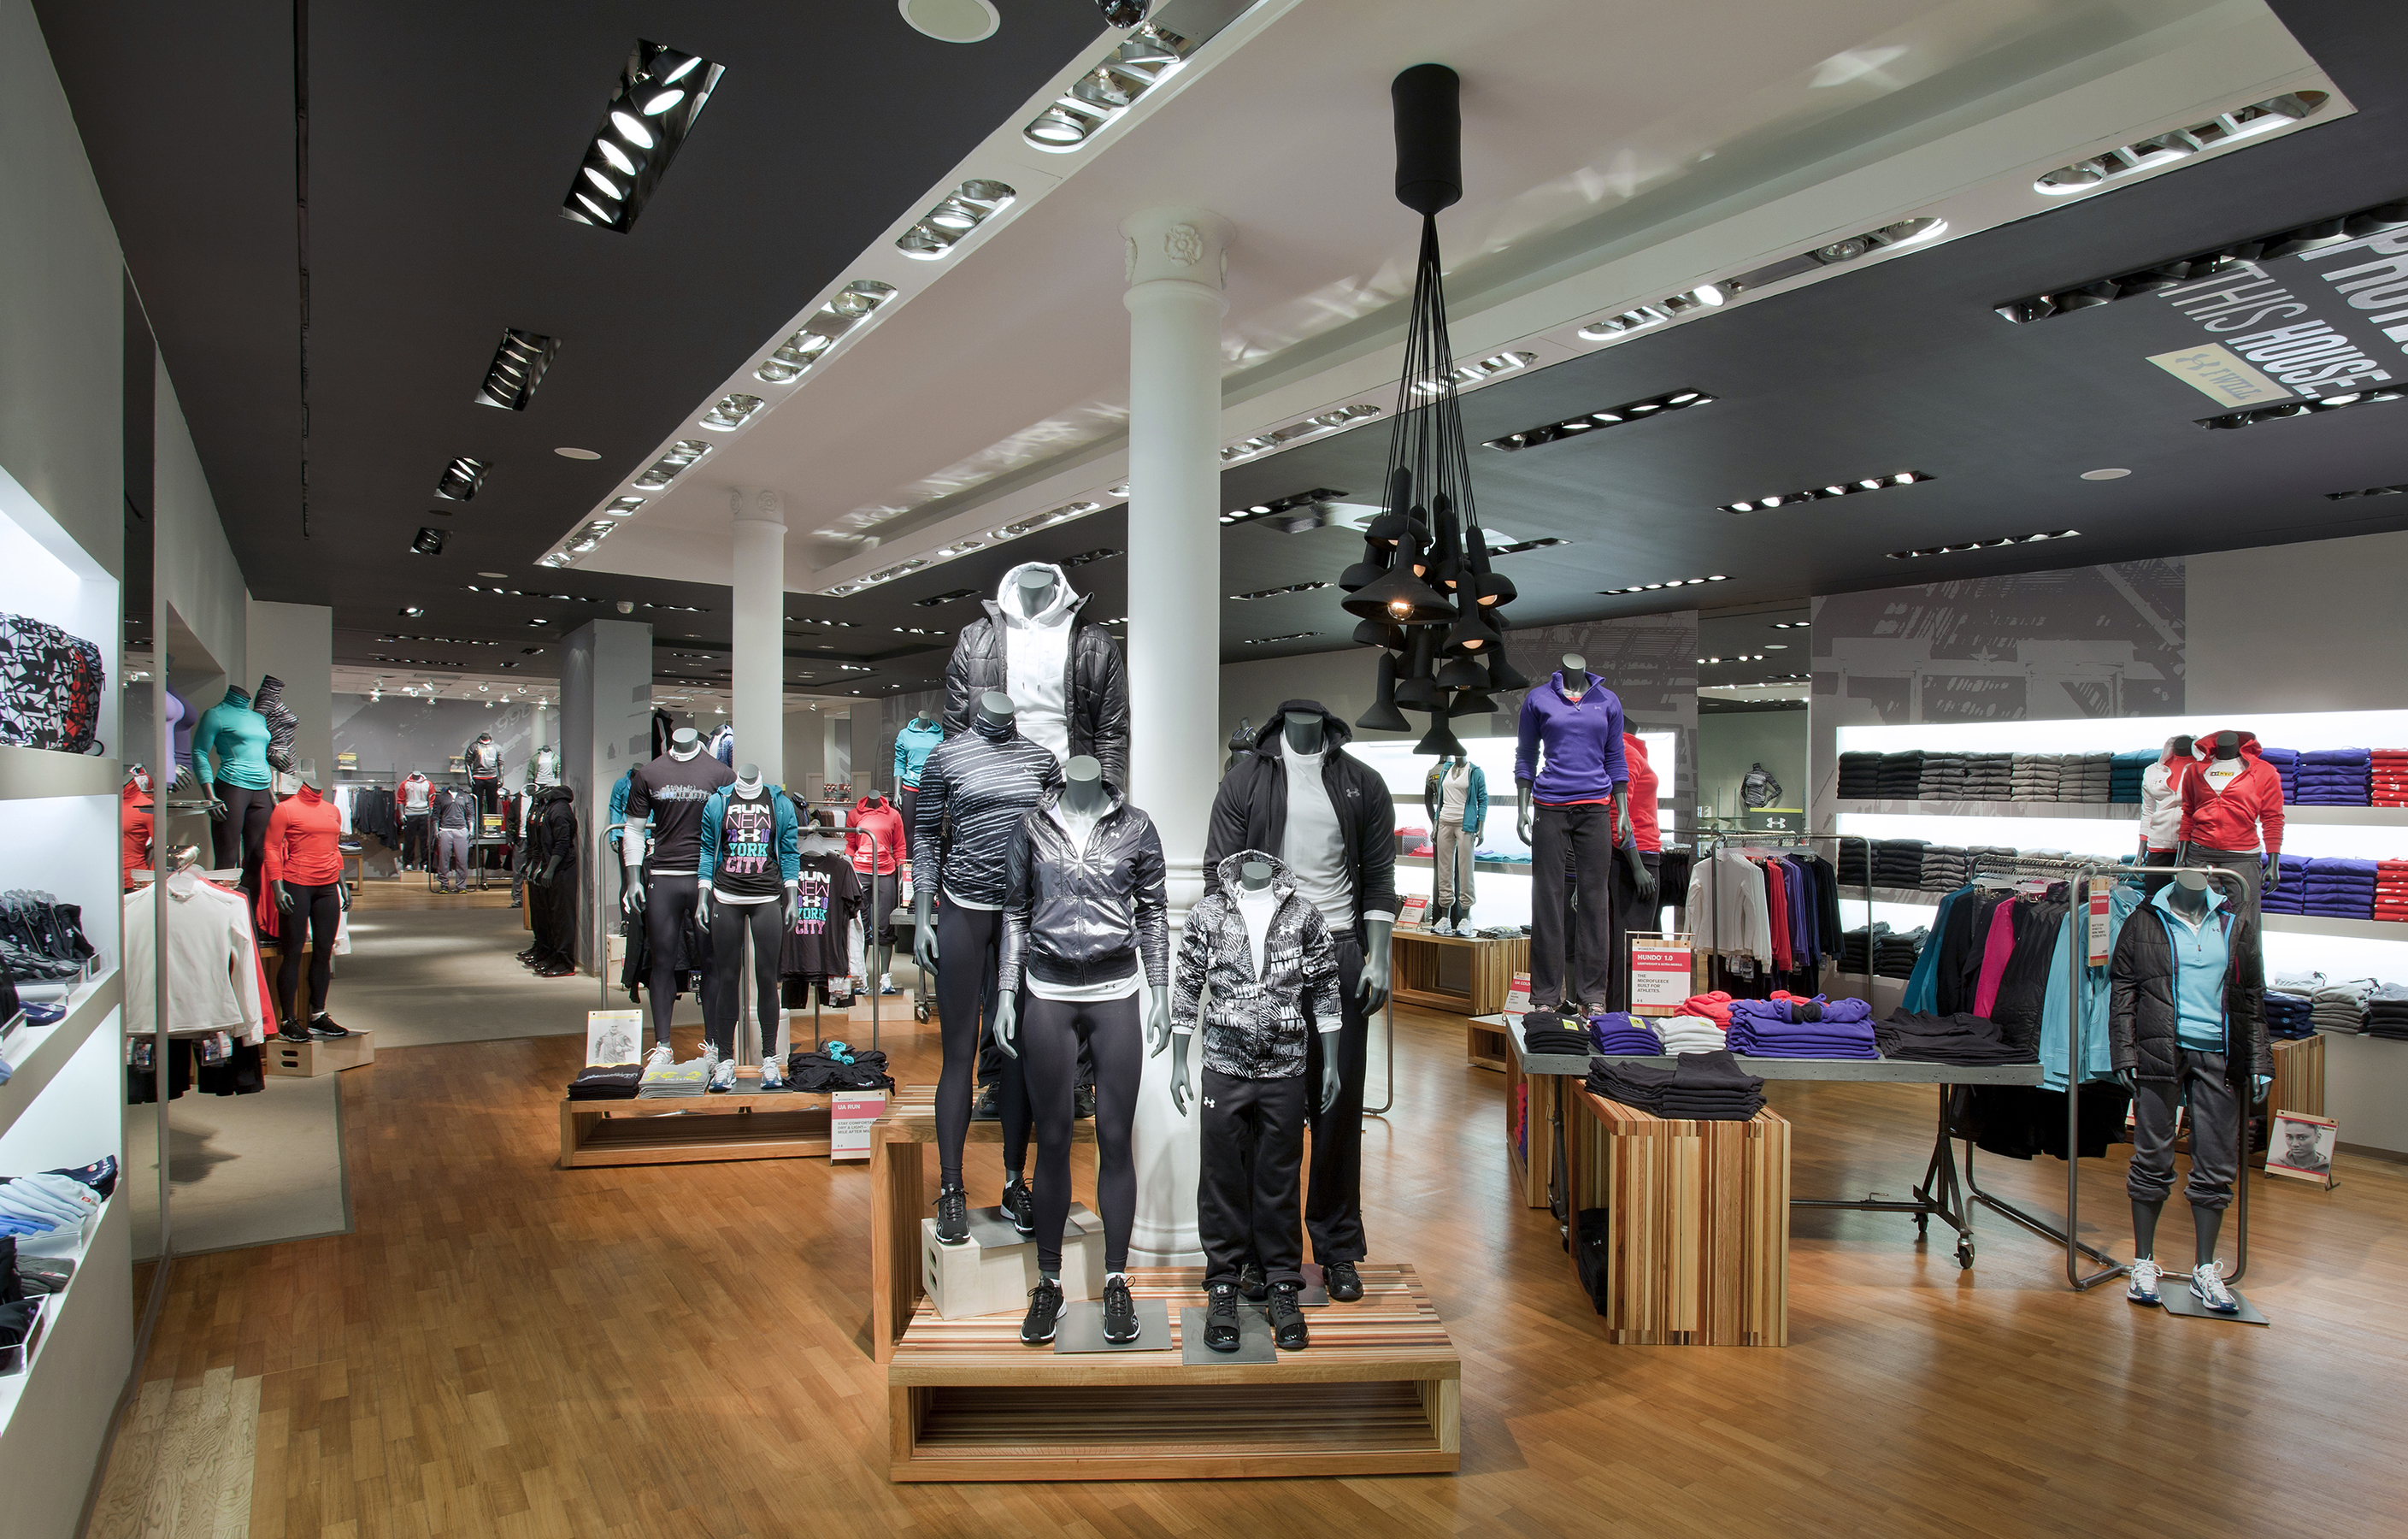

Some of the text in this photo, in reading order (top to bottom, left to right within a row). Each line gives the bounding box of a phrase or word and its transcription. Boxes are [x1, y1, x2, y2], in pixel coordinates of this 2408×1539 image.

[2158, 265, 2308, 332] THIS
[727, 804, 770, 815] RUN
[726, 813, 771, 828] NEW
[728, 842, 768, 857] YORK
[725, 857, 767, 874] CITY
[795, 919, 826, 935] CITY
